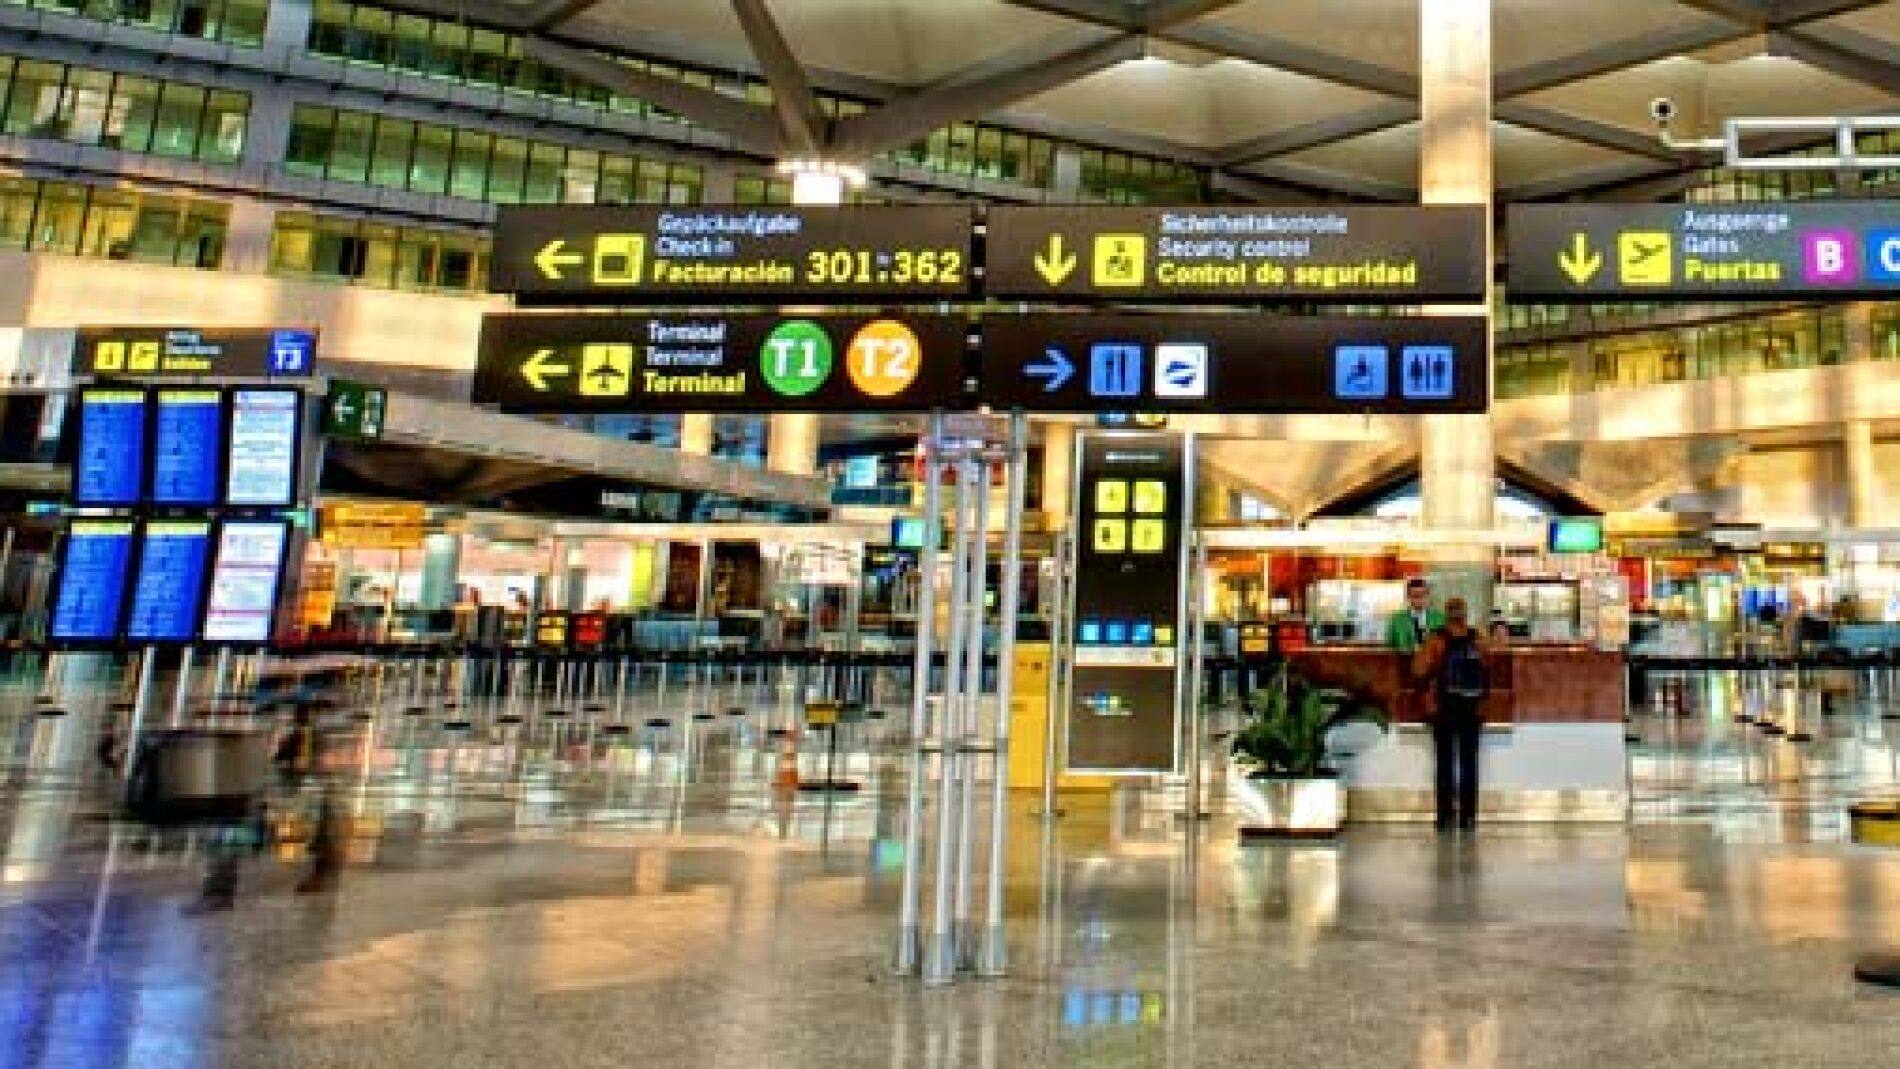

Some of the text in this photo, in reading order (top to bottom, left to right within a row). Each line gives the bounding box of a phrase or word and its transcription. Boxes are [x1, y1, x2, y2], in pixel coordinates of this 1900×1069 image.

[656, 236, 711, 256] Check
[1158, 237, 1310, 261] Security control
[1816, 240, 1842, 272] B
[653, 258, 794, 284] Facturación
[1156, 261, 1416, 290] Control de seguridad
[1683, 257, 1782, 283] Puertas
[648, 321, 726, 343] Terminal
[645, 345, 723, 366] Terminal
[769, 337, 910, 378] T1 T2
[643, 371, 746, 394] Terminal
